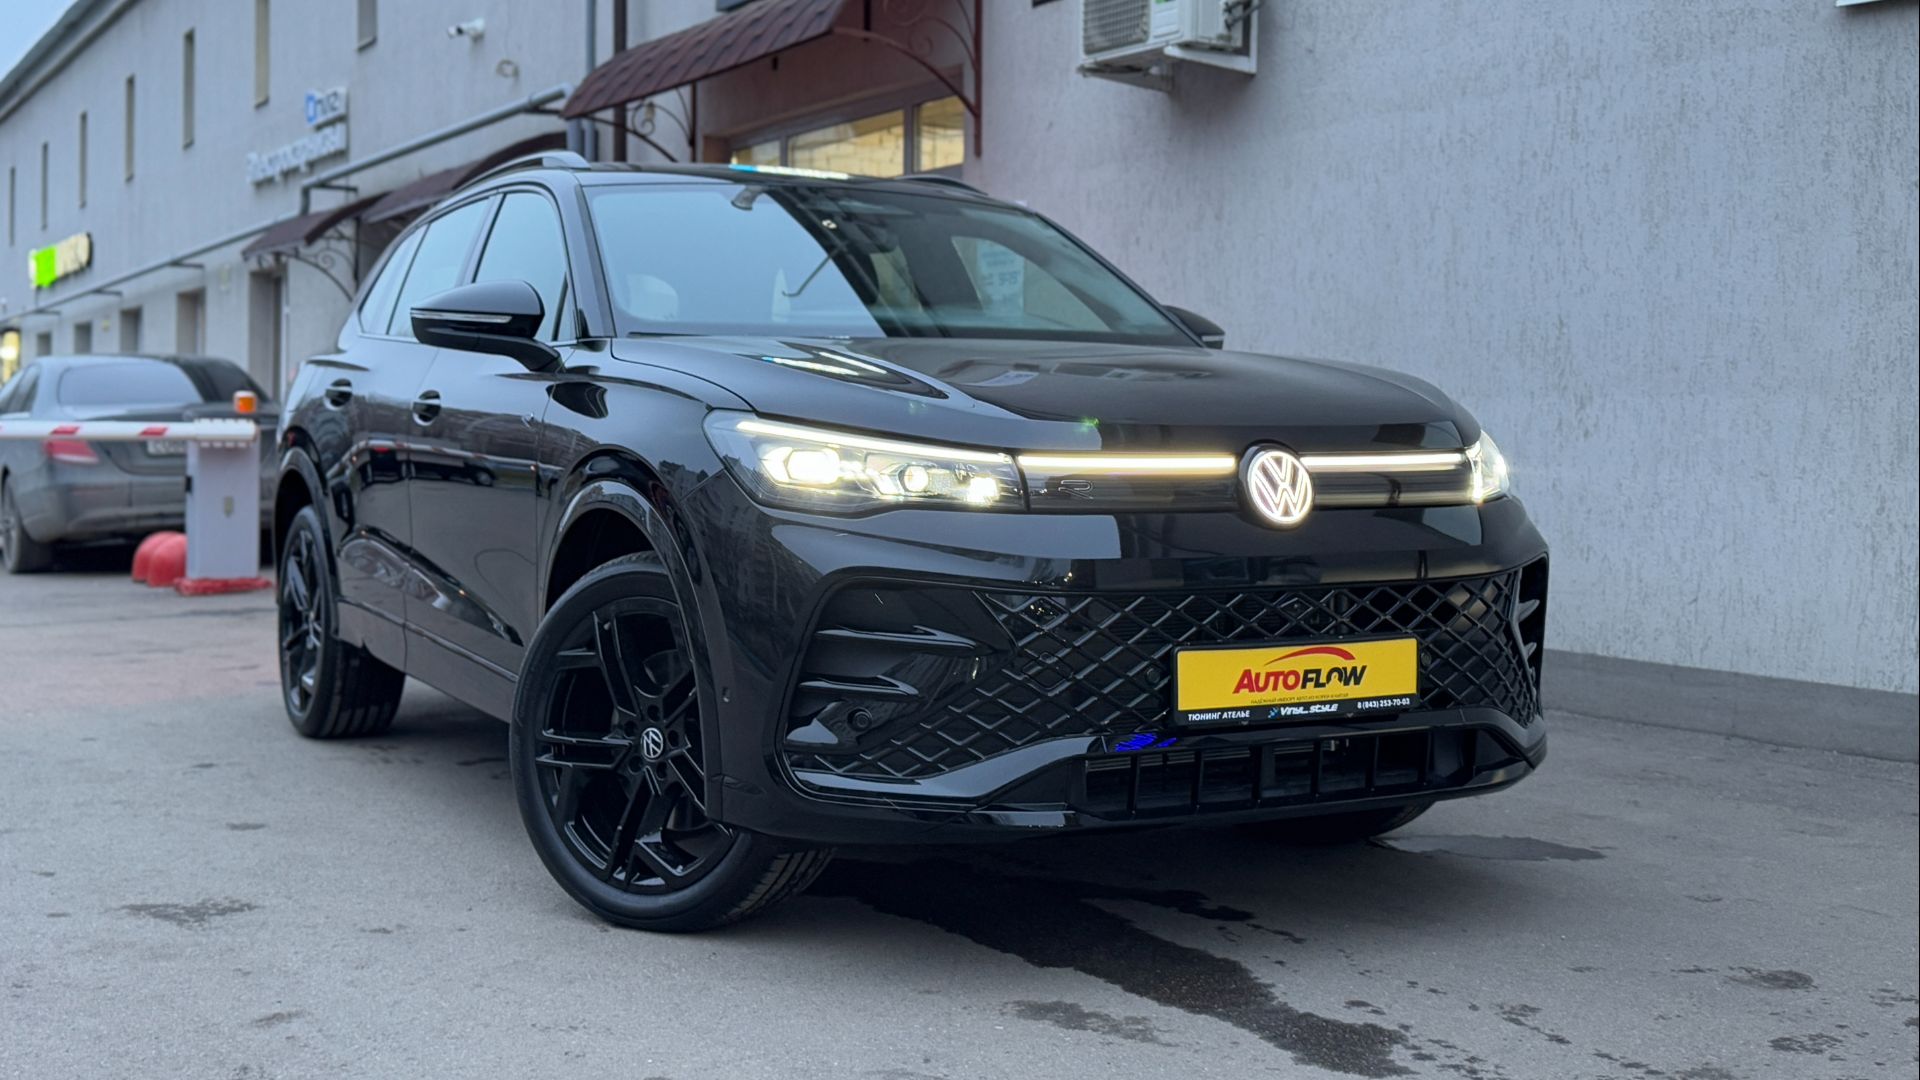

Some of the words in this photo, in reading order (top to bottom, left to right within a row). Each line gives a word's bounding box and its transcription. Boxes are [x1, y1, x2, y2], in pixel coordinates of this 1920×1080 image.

[1357, 701, 1362, 709] 8
[1362, 700, 1379, 710] (843)
[1188, 711, 1221, 721] ТЮНИНГ
[1222, 710, 1250, 719] АТЕЛЬЕ
